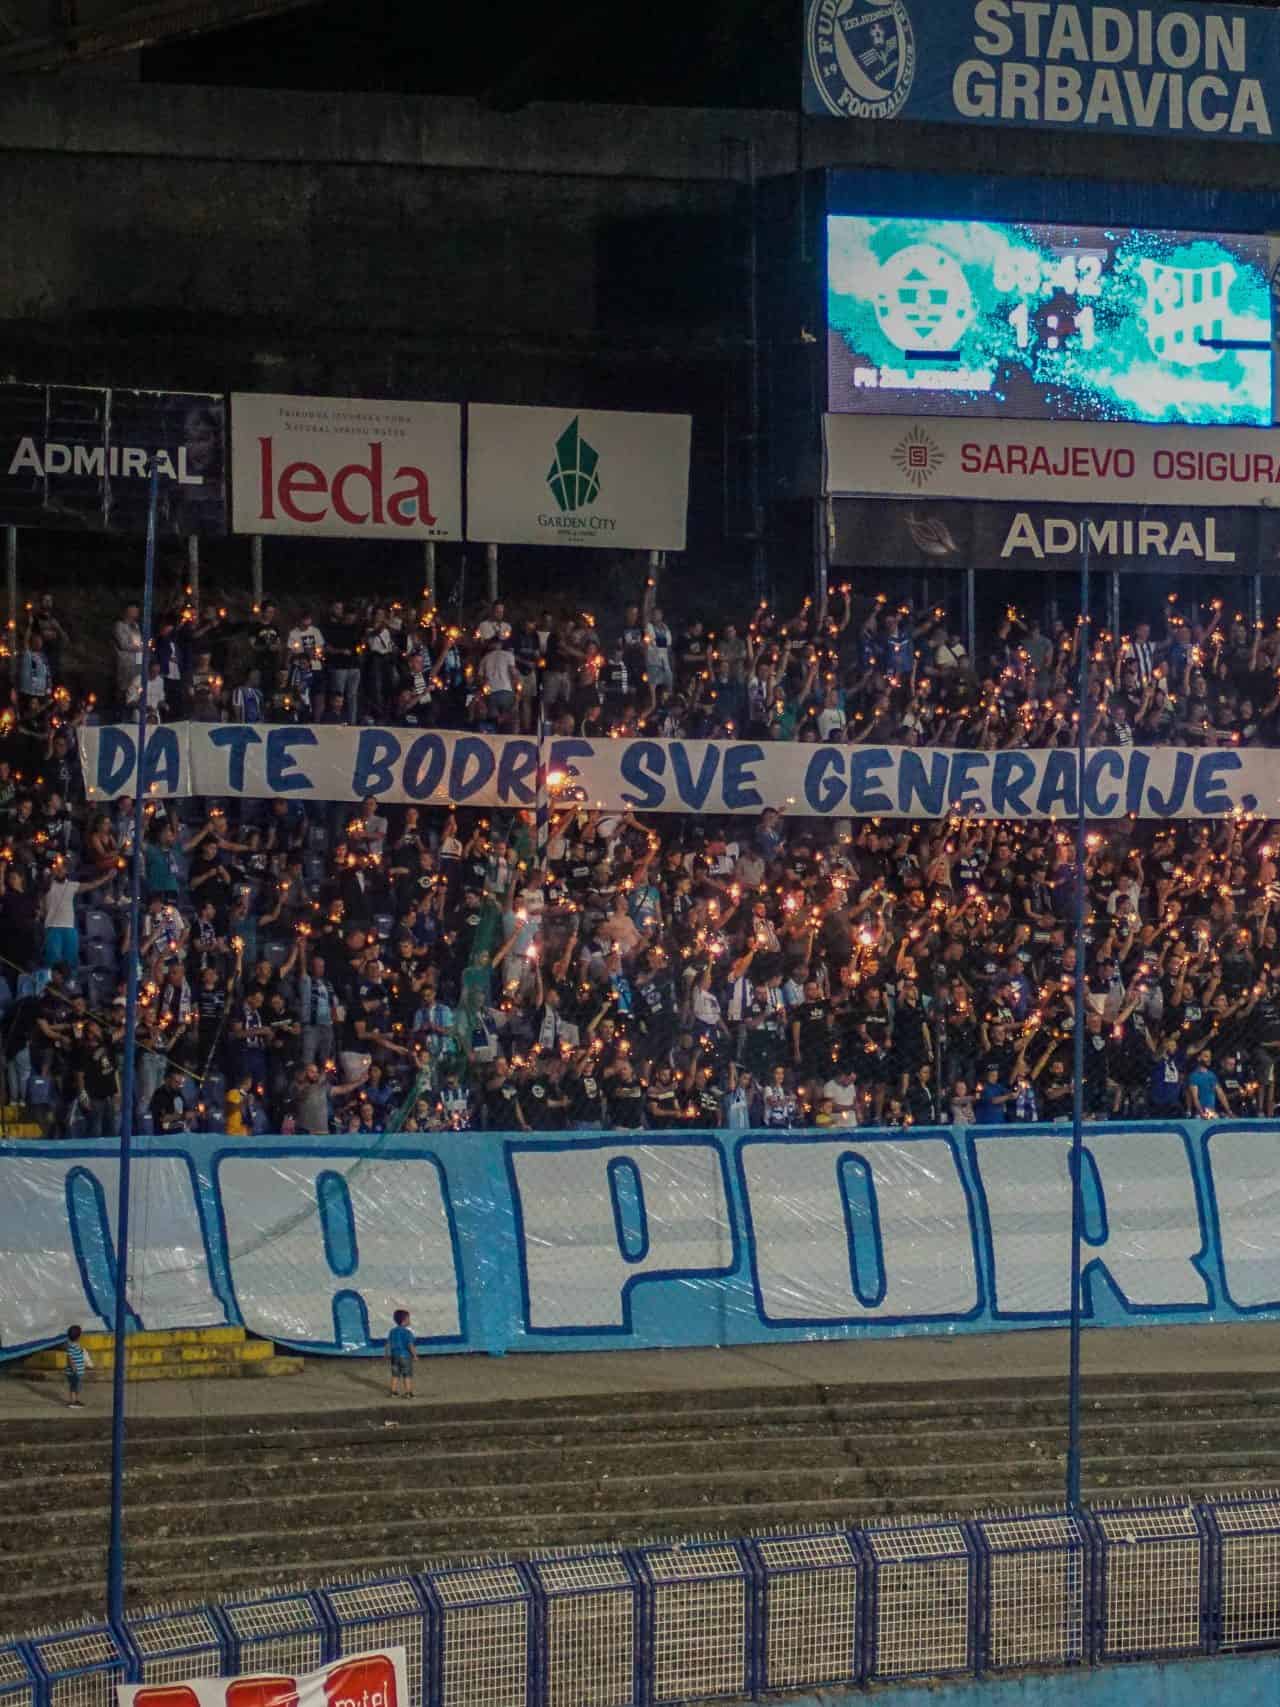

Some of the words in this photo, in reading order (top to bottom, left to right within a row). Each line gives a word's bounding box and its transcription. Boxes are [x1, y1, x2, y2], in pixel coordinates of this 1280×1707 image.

[973, 0, 1246, 72] STADION
[952, 59, 1273, 136] GRBAVICA
[1008, 302, 1095, 350] 1:1
[8, 436, 204, 485] ADMIRAL
[257, 435, 438, 527] leda
[960, 443, 1136, 479] SARAJEVO
[1000, 513, 1236, 562] ADMIRAL
[100, 725, 179, 796] DA
[208, 726, 319, 792] TE
[351, 728, 594, 808] BODRE
[620, 741, 765, 818] SVE
